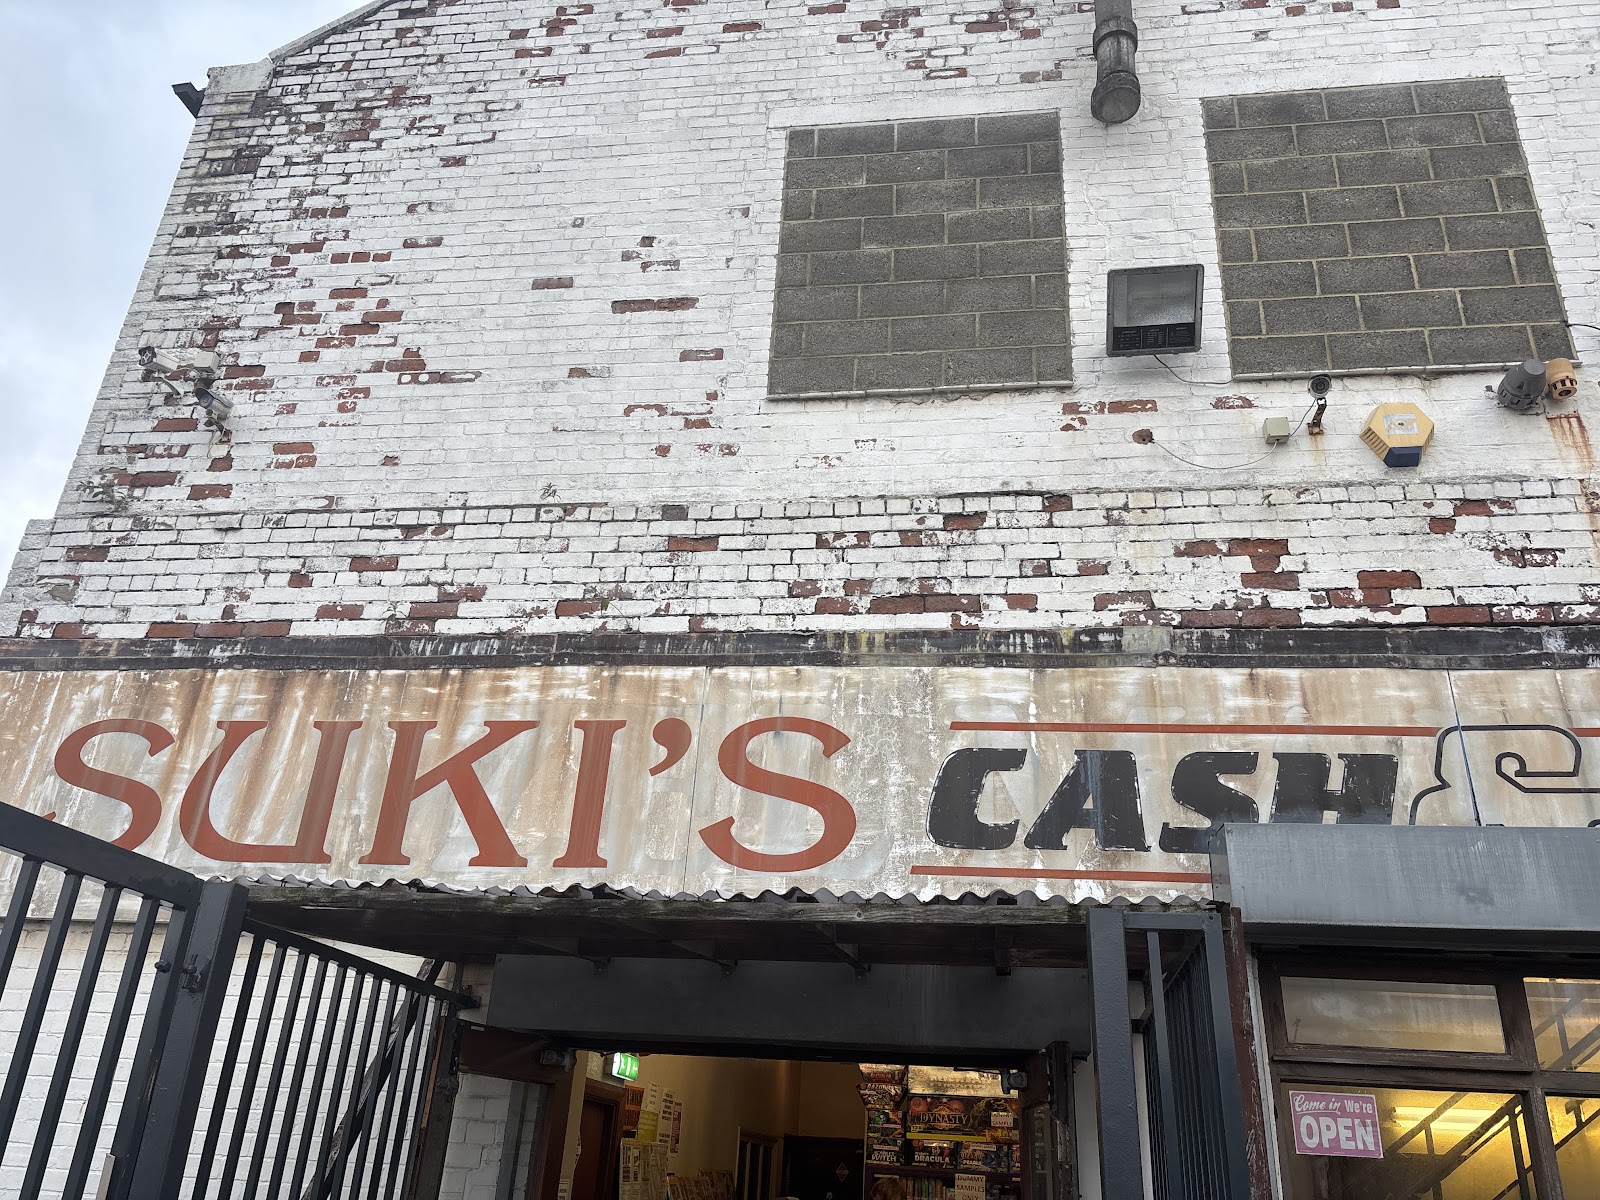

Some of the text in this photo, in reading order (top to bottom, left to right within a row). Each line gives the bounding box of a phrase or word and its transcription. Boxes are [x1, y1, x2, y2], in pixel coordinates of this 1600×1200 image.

[44, 716, 858, 873] SUKI'S
[926, 748, 1399, 853] CASH
[1294, 1094, 1373, 1115] Come in We're
[920, 1112, 969, 1125] DYNASTY
[1300, 1115, 1375, 1151] OPEN
[914, 1155, 950, 1164] DRACULA
